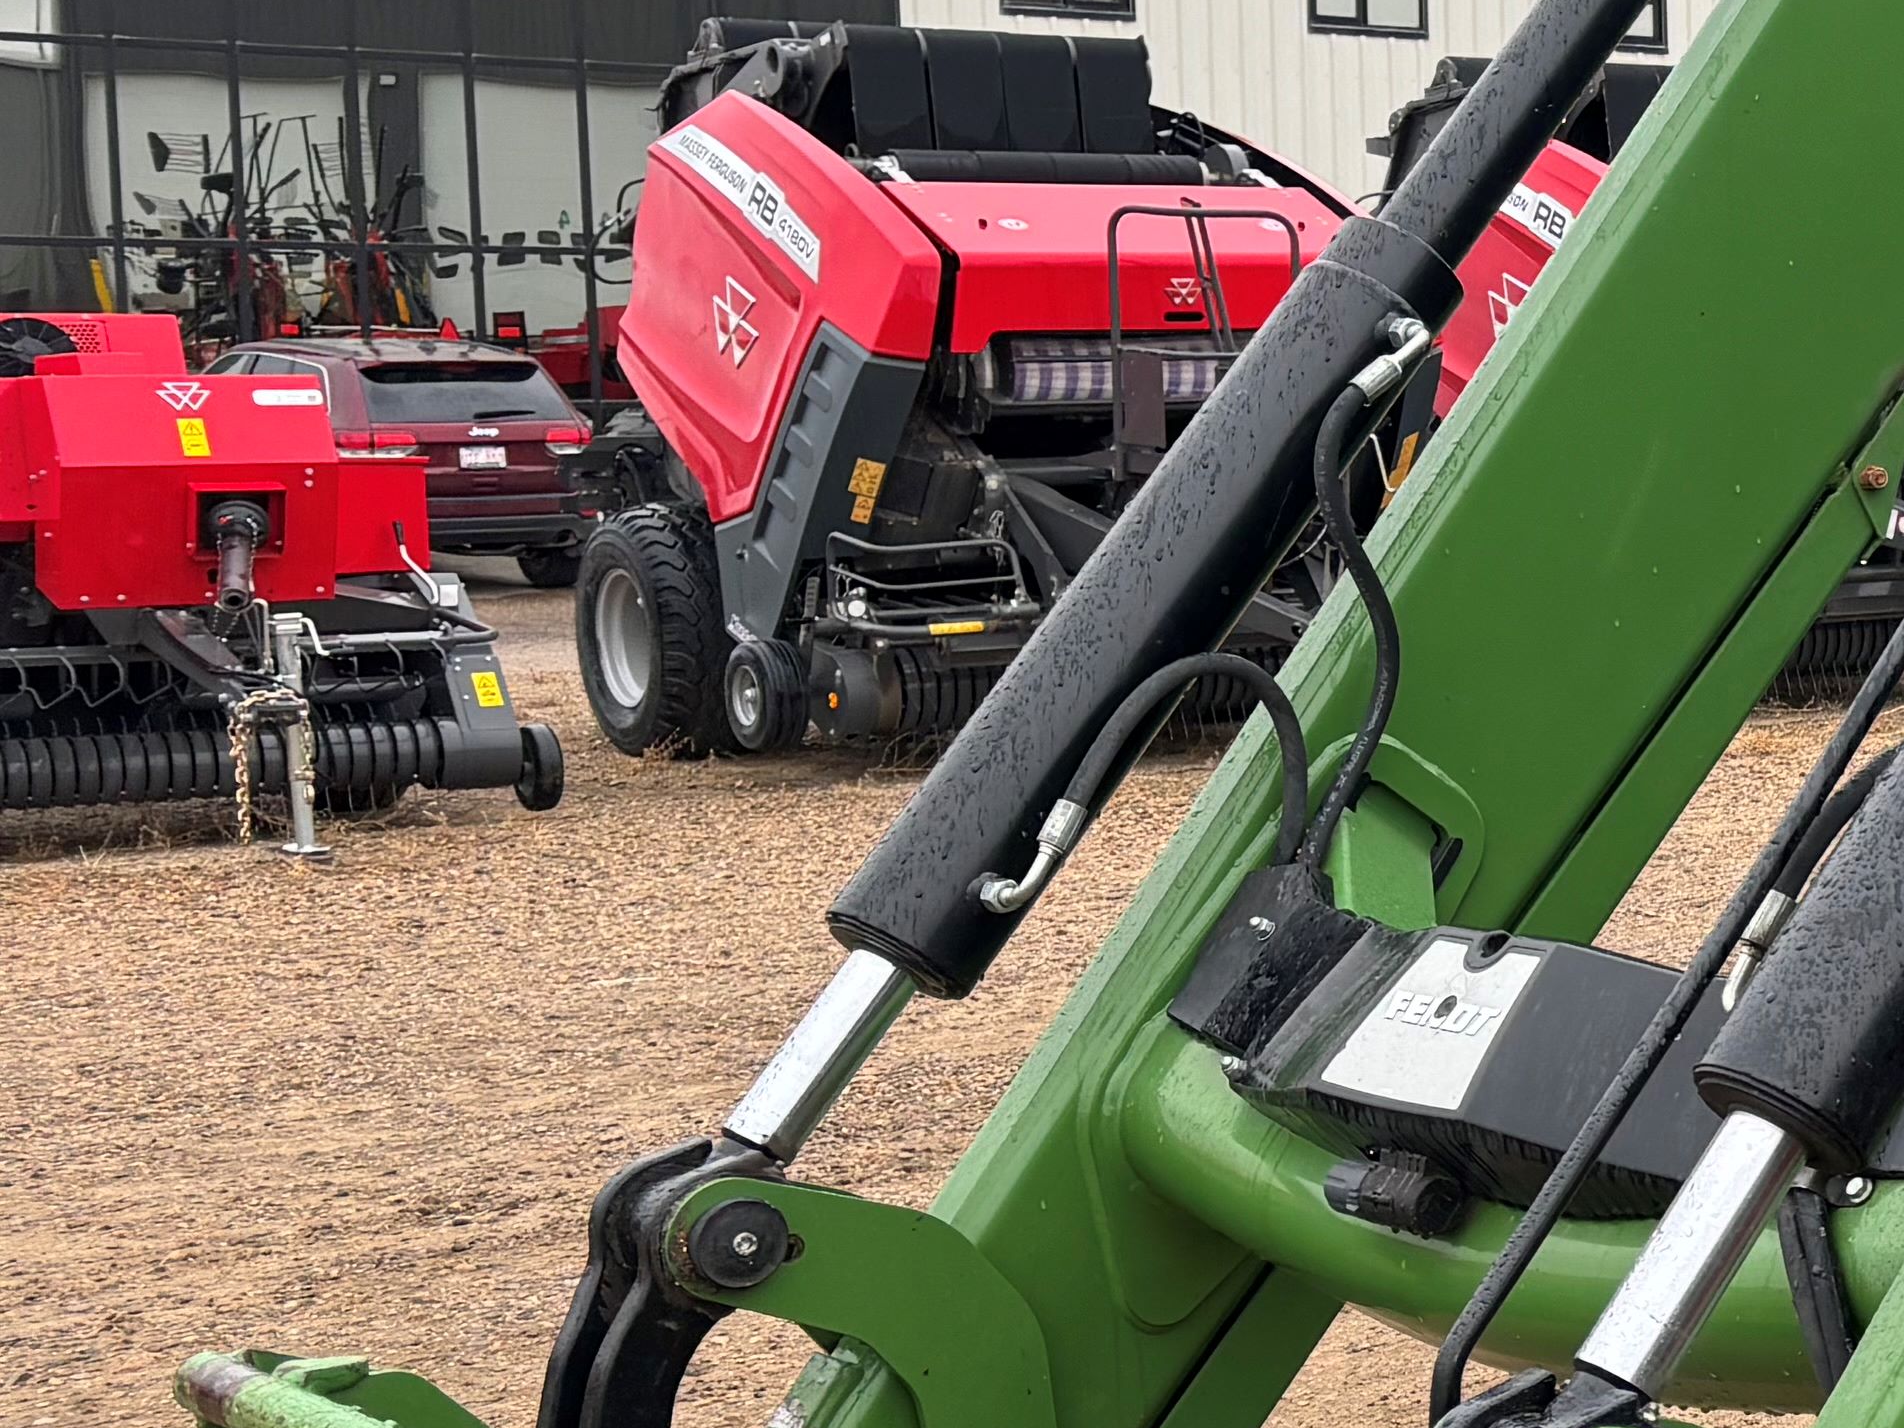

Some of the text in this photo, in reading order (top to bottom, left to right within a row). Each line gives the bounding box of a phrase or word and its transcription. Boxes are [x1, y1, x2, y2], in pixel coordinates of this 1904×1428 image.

[678, 134, 815, 259] MASSEY FERGUSON RB 4180V
[1532, 199, 1567, 240] RB
